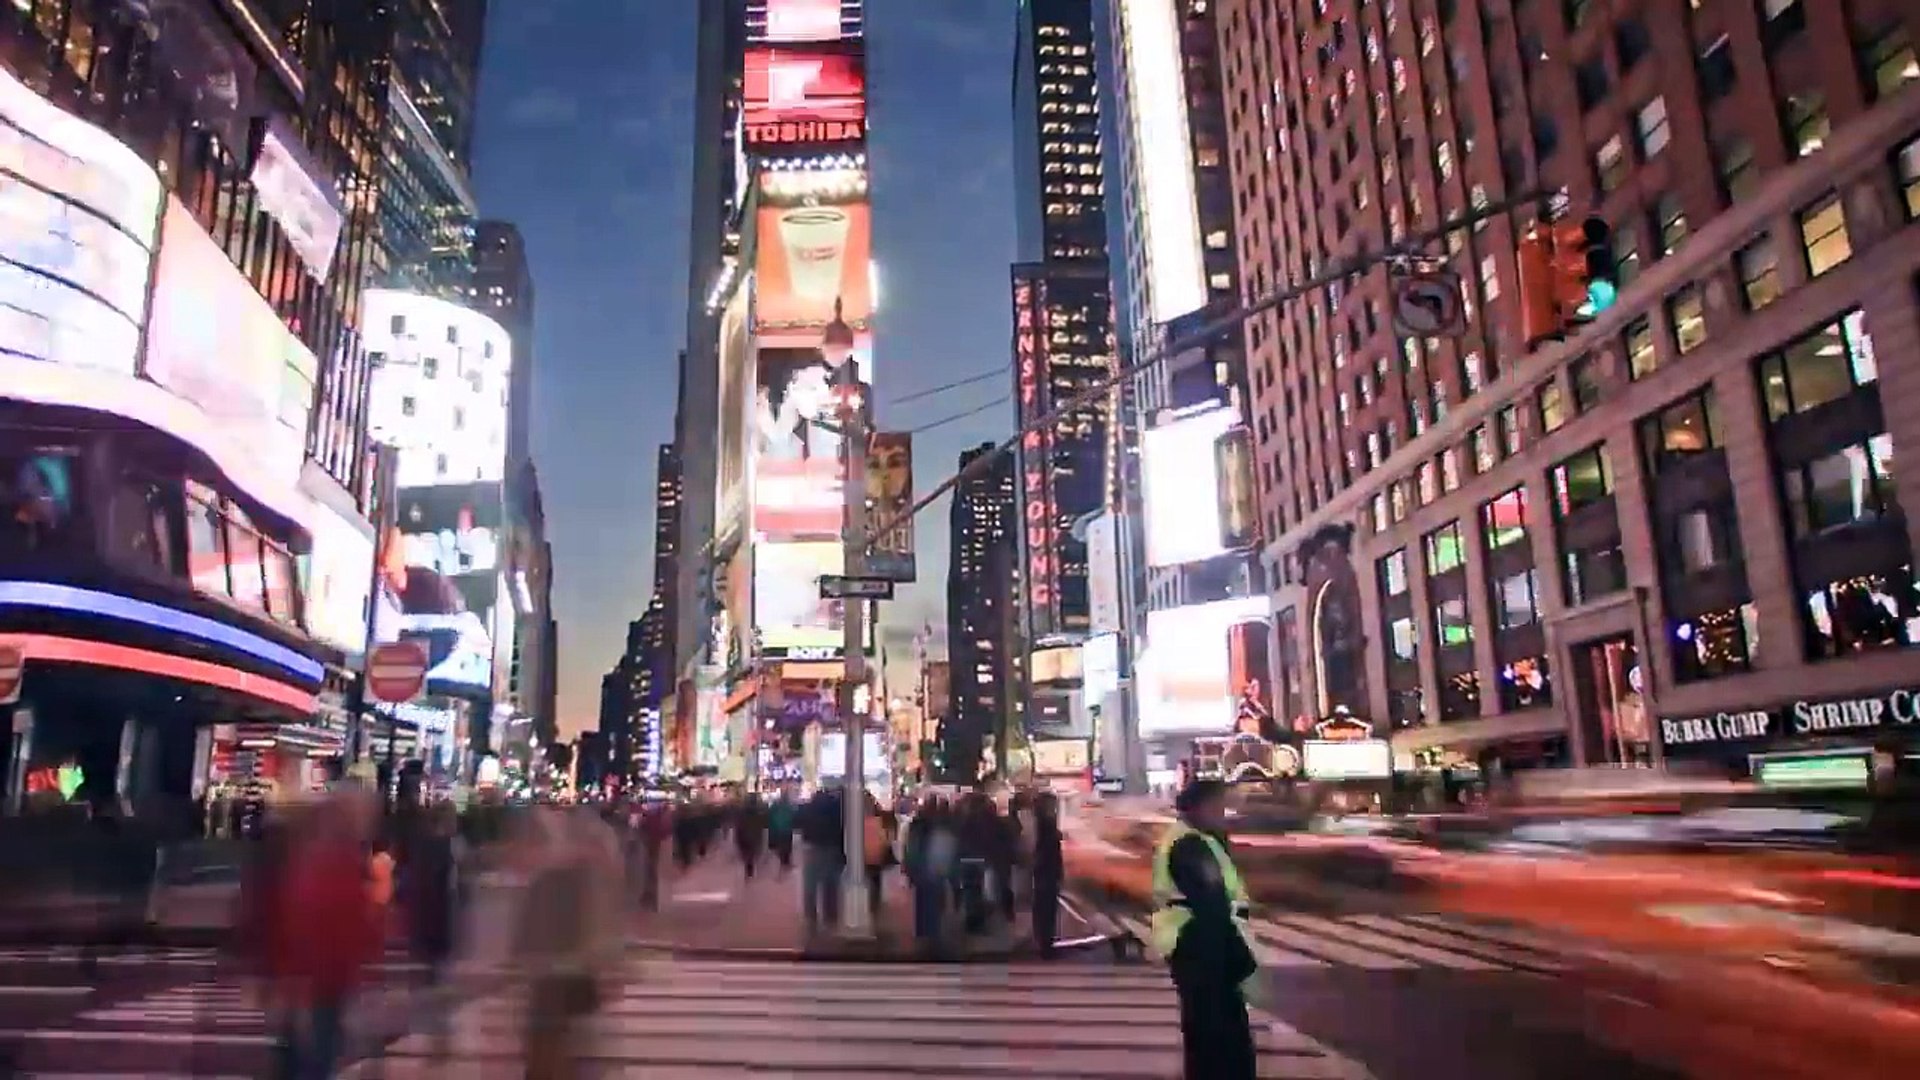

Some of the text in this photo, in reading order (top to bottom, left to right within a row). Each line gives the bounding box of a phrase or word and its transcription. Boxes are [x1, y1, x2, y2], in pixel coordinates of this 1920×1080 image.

[745, 117, 861, 142] TOSHIBA
[1015, 284, 1035, 405] ERNST
[1025, 471, 1050, 605] YOUNG
[1662, 719, 1716, 744] BUBBA
[1717, 712, 1769, 738] GUMP
[1795, 698, 1883, 733] SHRIMP
